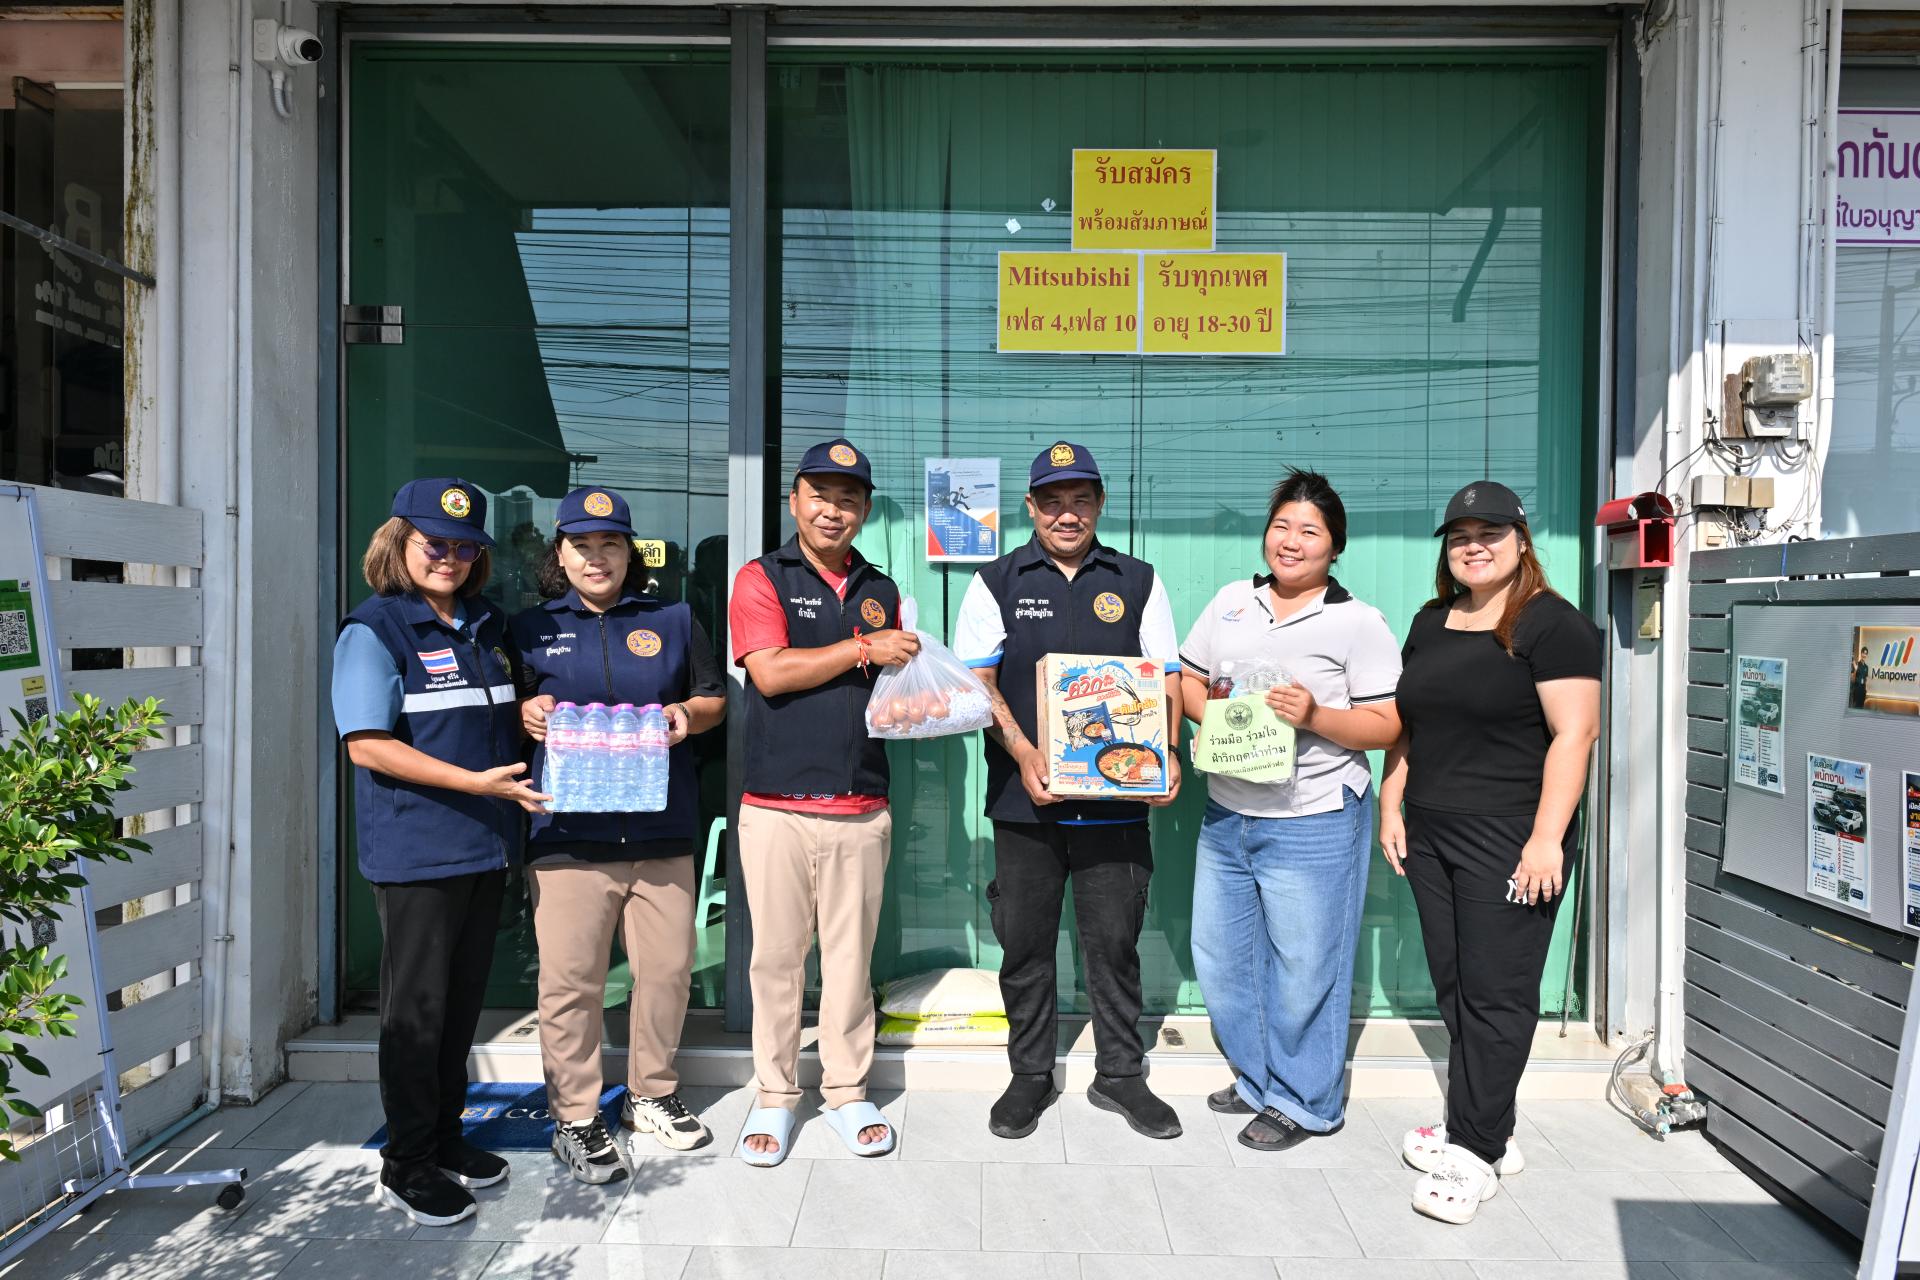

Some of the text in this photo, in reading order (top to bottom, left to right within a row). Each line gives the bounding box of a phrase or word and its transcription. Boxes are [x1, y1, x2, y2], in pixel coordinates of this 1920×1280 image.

[1838, 127, 1920, 179] กทัน
[1095, 156, 1192, 185] รับสมัคร
[1078, 207, 1208, 231] พร้อมสัมภาษณ์
[1008, 266, 1131, 287] Mitsubishi
[1158, 260, 1268, 296] รับทุกเพศ
[1006, 307, 1044, 332] เฟส
[1115, 314, 1137, 333] 10
[1153, 307, 1273, 340] อายุ 18-30 ปี
[1871, 667, 1918, 683] Manpower
[1209, 725, 1278, 747] ร่วมมือ ร่วมใจ
[1813, 769, 1845, 785] พนักงาน
[459, 1107, 549, 1120] ELCO
